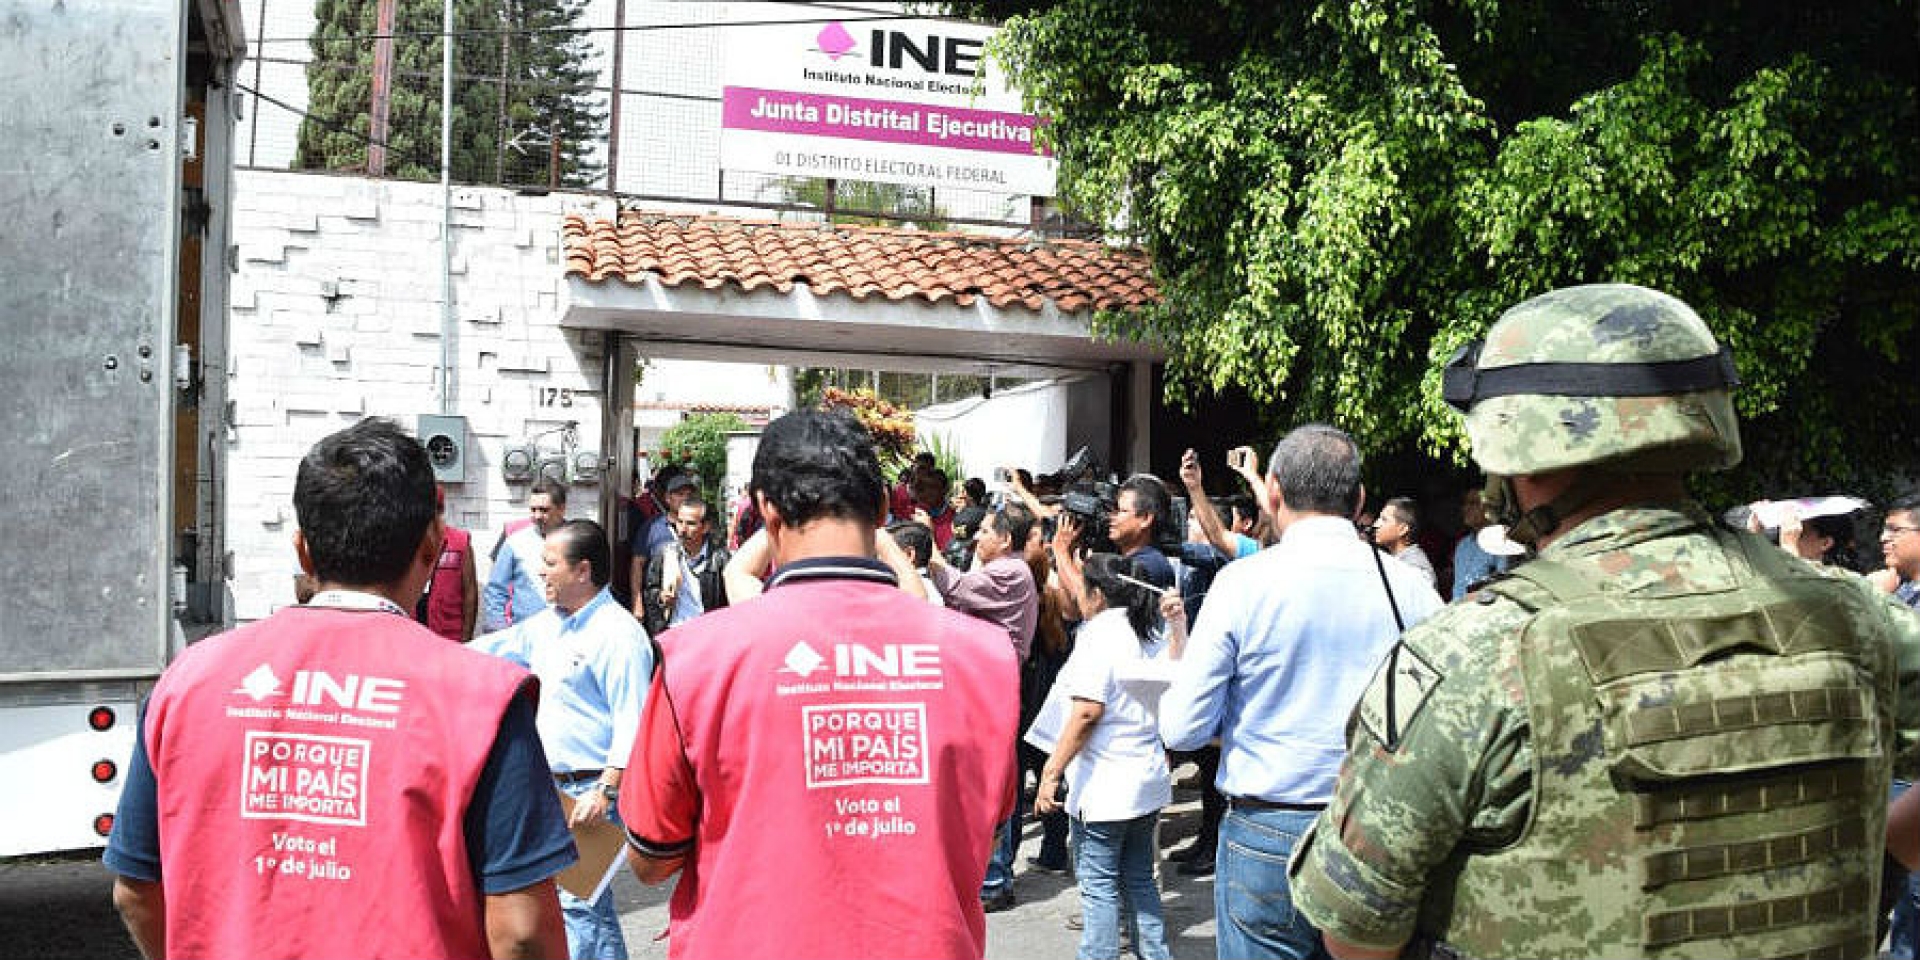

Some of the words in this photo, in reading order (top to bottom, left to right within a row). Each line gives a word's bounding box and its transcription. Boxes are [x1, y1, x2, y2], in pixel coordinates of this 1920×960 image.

[870, 29, 987, 77] INE
[803, 68, 861, 85] Instituto
[865, 74, 924, 91] Nacional
[751, 98, 819, 124] Junta
[826, 104, 920, 133] Distrital
[927, 113, 1032, 143] Ejecutiva
[797, 152, 862, 172] DISTRITO
[865, 159, 943, 180] ELECTORAL
[946, 166, 1008, 185] FEDERAL
[539, 387, 573, 408] 175
[834, 643, 942, 677] INE
[291, 669, 406, 712] INE
[811, 711, 918, 733] PORQUE
[254, 740, 360, 768] PORQUE
[813, 738, 845, 761] MI
[852, 730, 919, 759] PAÍS
[251, 766, 288, 794] MI
[295, 765, 358, 799] PAÍS
[813, 763, 838, 778] ME
[842, 760, 918, 776] IMPORTA
[249, 793, 278, 810] ME
[283, 795, 357, 816] IMPORTA
[835, 798, 880, 815] Voto
[883, 795, 900, 812] el
[844, 817, 870, 836] de
[871, 816, 917, 840] julio
[272, 832, 316, 852] Voto
[317, 836, 336, 856] el
[280, 855, 306, 874] de
[307, 860, 352, 881] julio
